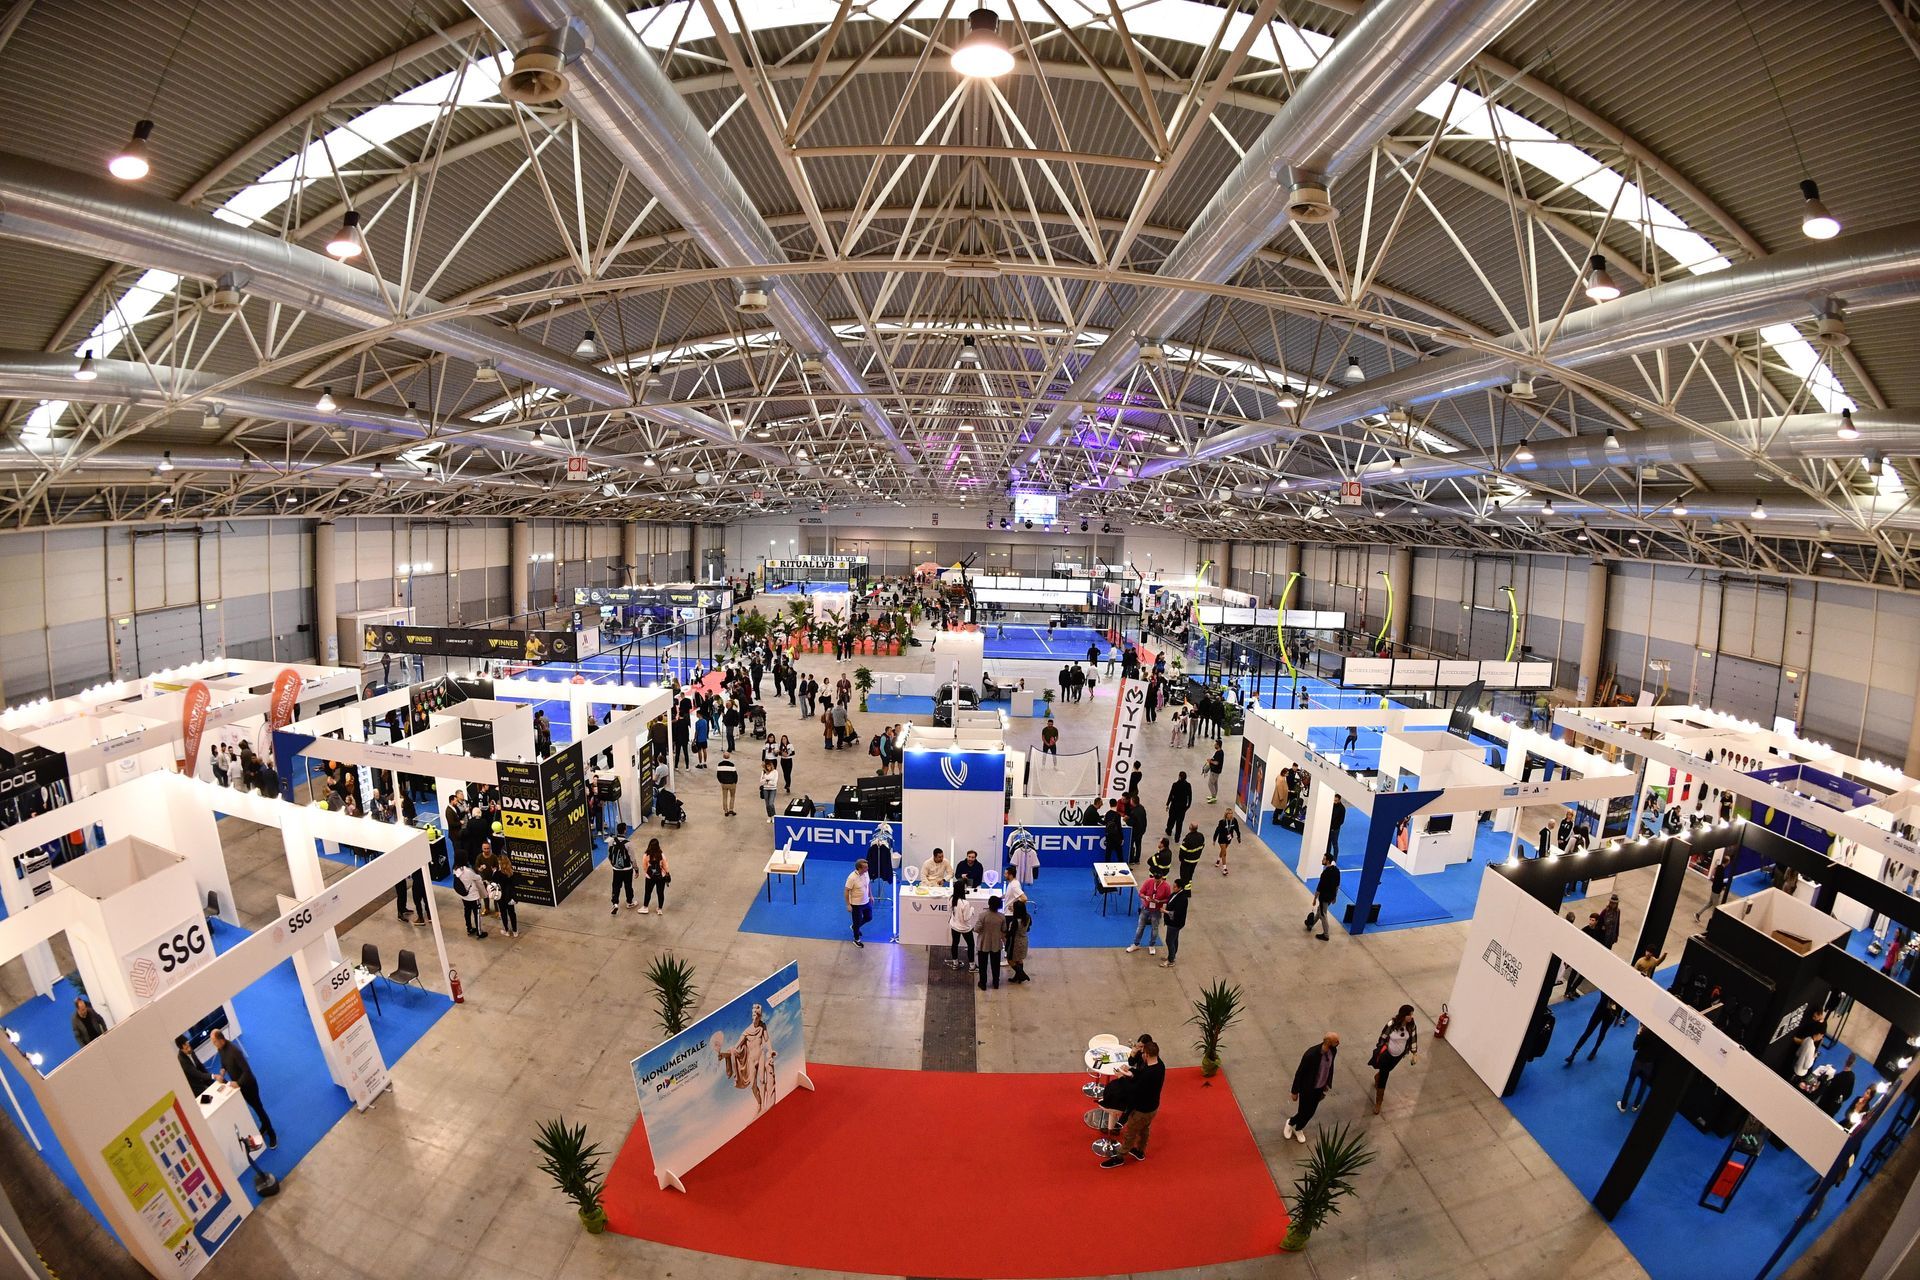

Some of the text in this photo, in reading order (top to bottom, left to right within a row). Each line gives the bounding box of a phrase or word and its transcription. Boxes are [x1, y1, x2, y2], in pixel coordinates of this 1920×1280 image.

[406, 635, 433, 644] WINNER
[489, 639, 519, 648] WINNER
[277, 675, 297, 718] GENERALI
[188, 689, 206, 737] GENERALI
[1113, 686, 1144, 792] MYTHOS
[502, 796, 540, 812] DAYS
[506, 814, 542, 830] 24-31
[567, 804, 586, 825] YOU
[786, 825, 873, 845] VIENT
[1033, 835, 1107, 850] IENT
[510, 850, 545, 860] ALLENATI
[288, 908, 313, 933] SSG
[158, 924, 206, 973] SSG
[1502, 948, 1523, 971] WORLD
[331, 968, 351, 990] SSG
[1499, 967, 1518, 988] STORE
[1502, 960, 1519, 979] PADEL
[1688, 1015, 1706, 1032] WORLD
[1688, 1023, 1702, 1039] PADEL
[1685, 1029, 1701, 1046] STORE
[642, 1040, 707, 1085] MONUMENTALE.
[124, 1137, 133, 1148] 3
